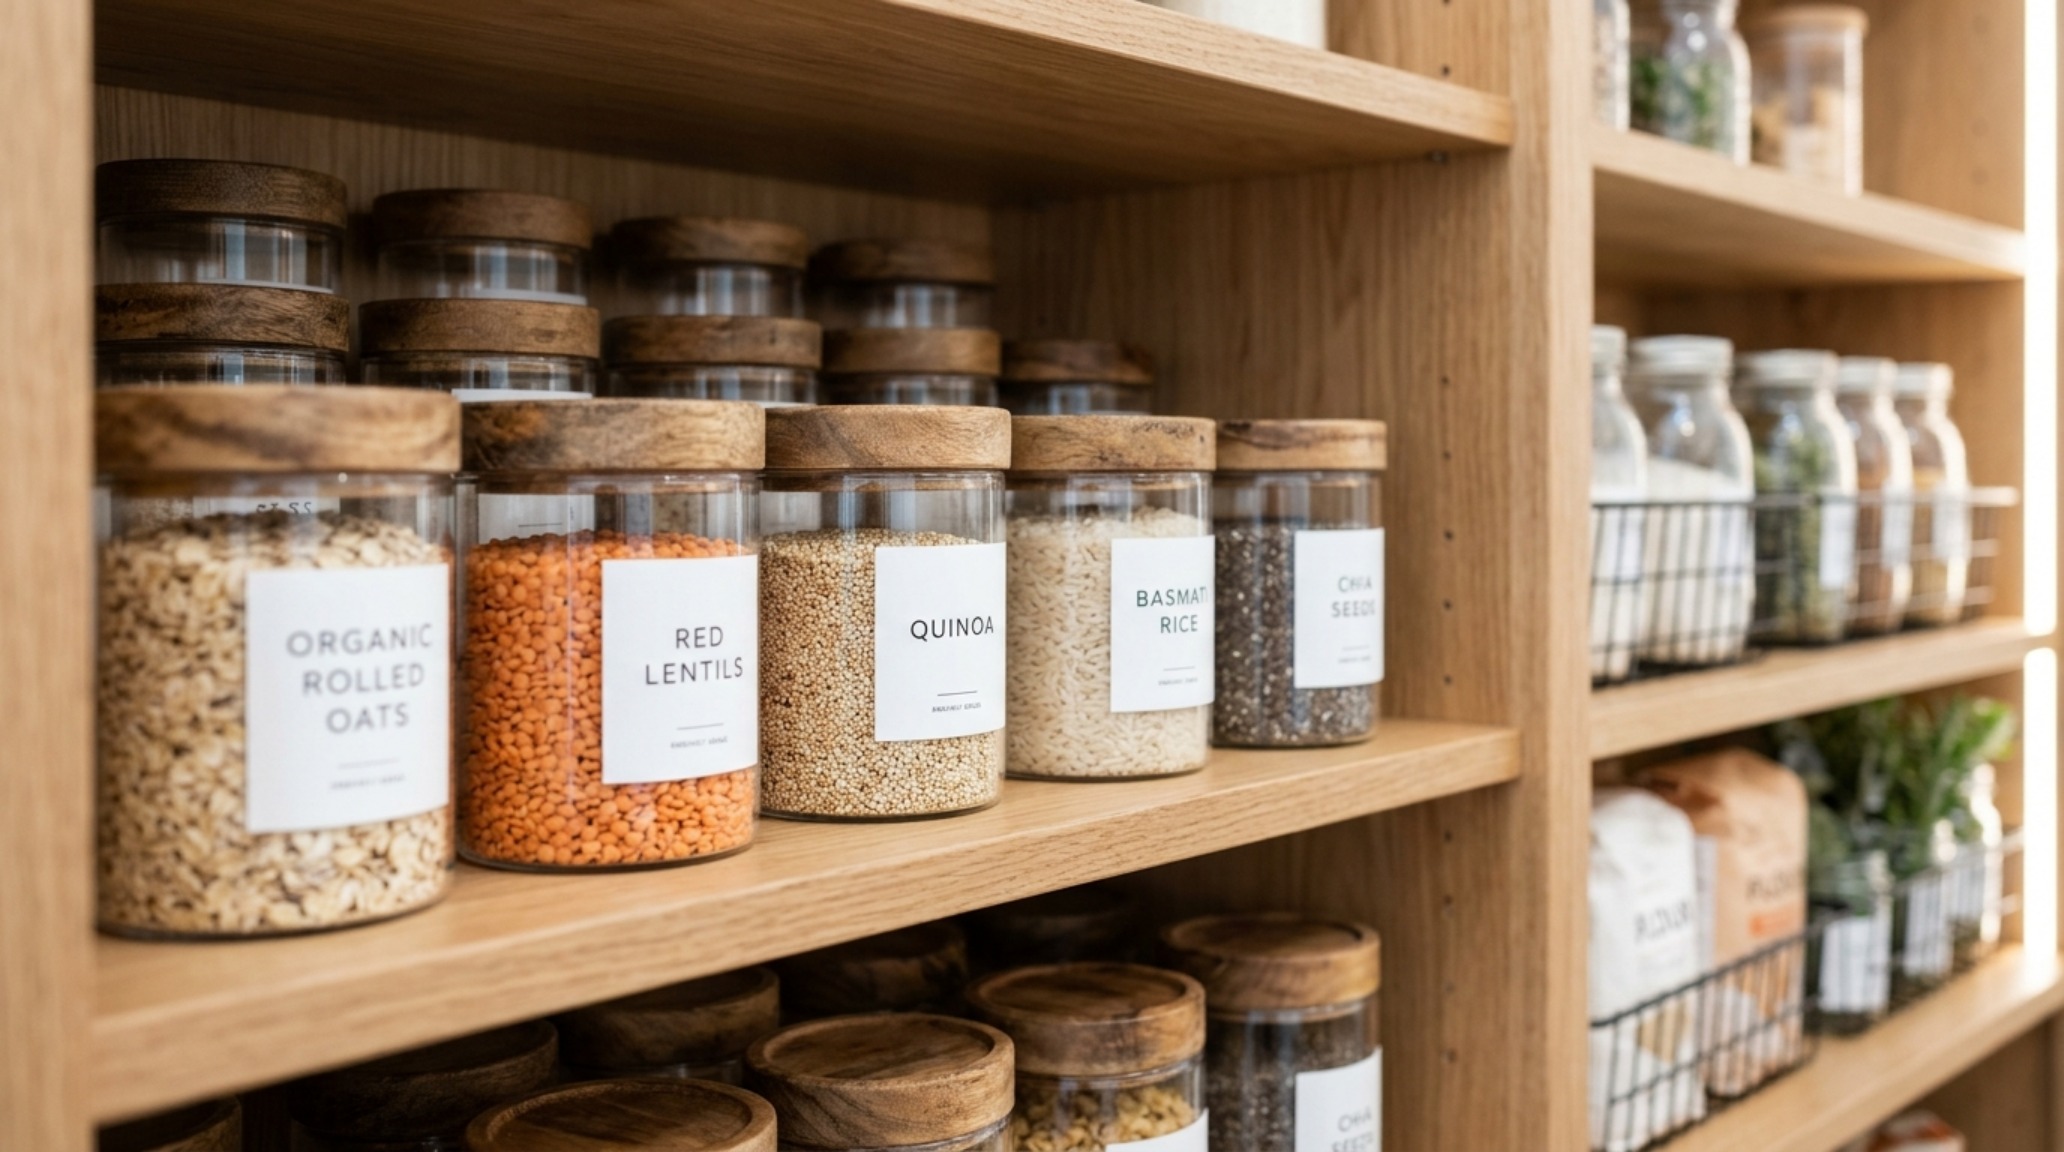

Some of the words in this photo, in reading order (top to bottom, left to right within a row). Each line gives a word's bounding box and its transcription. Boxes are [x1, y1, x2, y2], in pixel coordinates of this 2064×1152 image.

[675, 626, 724, 649] RED
[910, 616, 994, 641] QUINOA
[1160, 614, 1198, 634] RICE
[286, 623, 433, 657] ORGANIC
[302, 664, 424, 696] ROLLED
[646, 657, 743, 684] LENTILS
[325, 702, 409, 734] OATS
